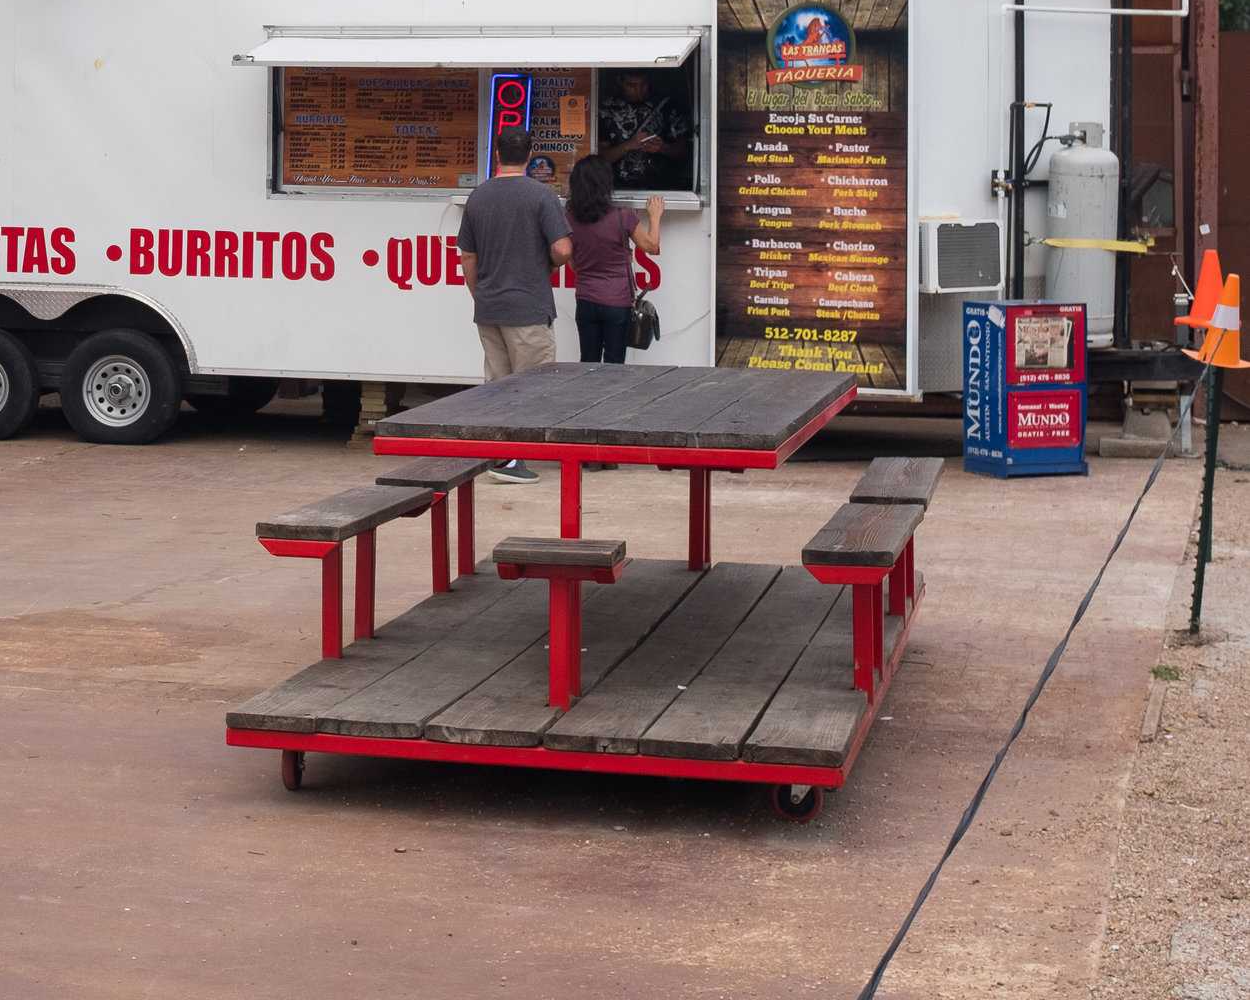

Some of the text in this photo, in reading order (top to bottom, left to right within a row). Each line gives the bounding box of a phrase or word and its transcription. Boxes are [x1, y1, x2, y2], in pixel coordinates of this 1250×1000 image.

[782, 46, 799, 56] LAS
[775, 67, 854, 83] TAQUERIA
[769, 114, 862, 125] Escoja Su Carne:
[765, 124, 867, 136] Choose Your Meat:
[533, 143, 575, 152] OMINGOS
[754, 142, 788, 152] Asada
[835, 143, 869, 153] Pastor
[817, 155, 887, 165] Marinated Pork
[754, 174, 781, 184] Pollo
[739, 187, 808, 197] Grilled Chicken
[752, 205, 792, 217] Lengua
[752, 239, 802, 250] Barbacoa
[833, 241, 875, 252] Chorizo
[129, 229, 336, 282] BURRITOS
[808, 253, 848, 262] Mexican
[754, 267, 788, 279] Tripas
[834, 272, 874, 282] Cabeza
[750, 280, 795, 291] Beef Tripe
[747, 307, 769, 316] Fried
[816, 310, 840, 319] Steak
[765, 327, 857, 342] 512-701-8287
[779, 345, 853, 359] Thank You
[749, 356, 884, 374] Please Come Again!
[966, 319, 982, 441] MUNDO
[1018, 412, 1070, 426] MUNDO
